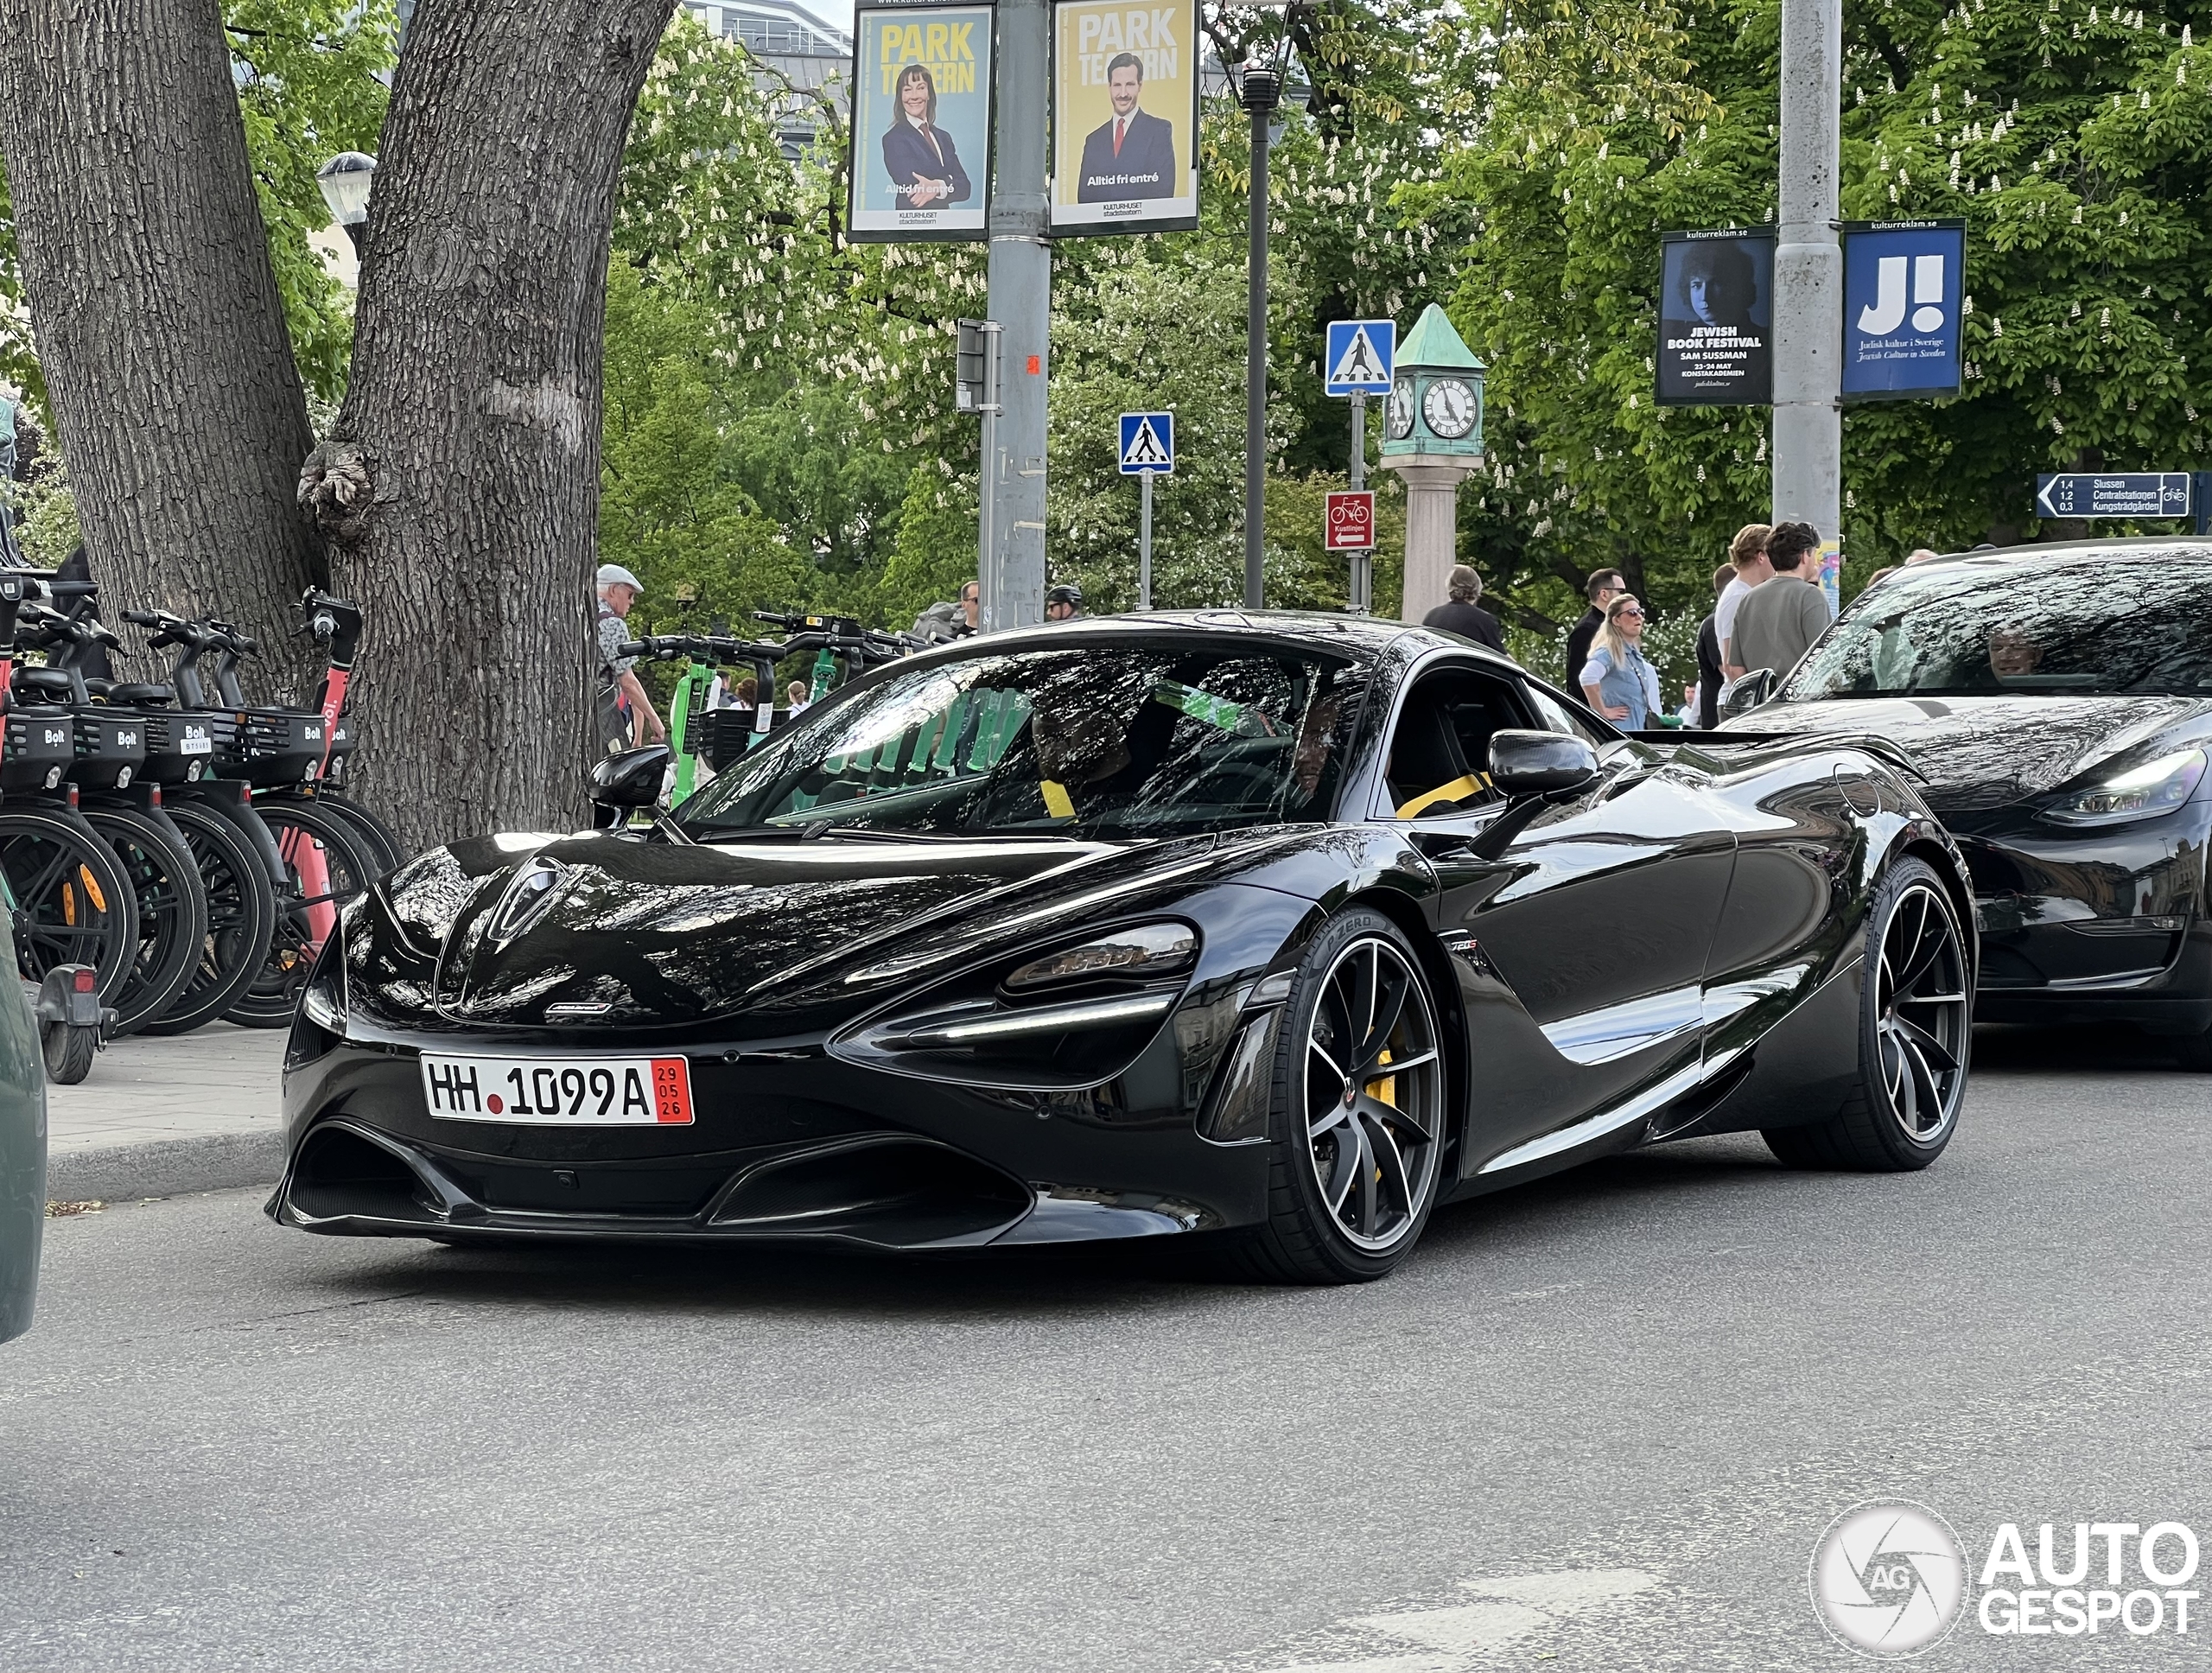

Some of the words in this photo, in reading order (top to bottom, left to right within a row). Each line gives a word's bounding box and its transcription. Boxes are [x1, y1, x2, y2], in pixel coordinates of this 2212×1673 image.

[1079, 7, 1177, 54] PARK
[880, 22, 975, 64] PARK
[1078, 47, 1178, 86] TERN
[1087, 175, 1116, 187] Alltid
[1116, 174, 1128, 184] fri
[1129, 172, 1159, 183] entré
[885, 184, 912, 194] Alltid
[913, 184, 925, 194] fri
[1103, 201, 1142, 211] KULTURHUSET
[1872, 219, 1937, 229] kulturreklam.se
[1687, 229, 1748, 239] kulturreklam.se
[1857, 255, 1944, 335] J!
[1690, 326, 1738, 337] JEWISH
[1667, 338, 1704, 349] BOOK
[1706, 337, 1762, 348] FESTIVAL
[1858, 340, 1884, 351] Judisk
[1885, 339, 1909, 347] kultur
[1910, 338, 1914, 347] i
[1914, 337, 1944, 347] Sverige
[1680, 352, 1700, 360] SAM
[1702, 351, 1747, 359] SUSSMAN
[2060, 480, 2074, 489] 1,4
[2094, 479, 2126, 489] Slussen
[2093, 490, 2157, 500] Centralstationen
[2059, 502, 2074, 512] 0,3
[2093, 501, 2159, 512] Kungsträdgården
[44, 728, 65, 745] Bolt
[118, 731, 137, 747] Bolt
[185, 725, 206, 739] Bolt
[305, 727, 321, 740] Bolt
[1327, 935, 1335, 951] P
[1337, 916, 1371, 940] ZERO
[658, 1067, 677, 1081] 29
[428, 1063, 482, 1114] HH
[507, 1067, 651, 1116] 1099A
[659, 1085, 678, 1097] 05
[661, 1101, 681, 1115] 26
